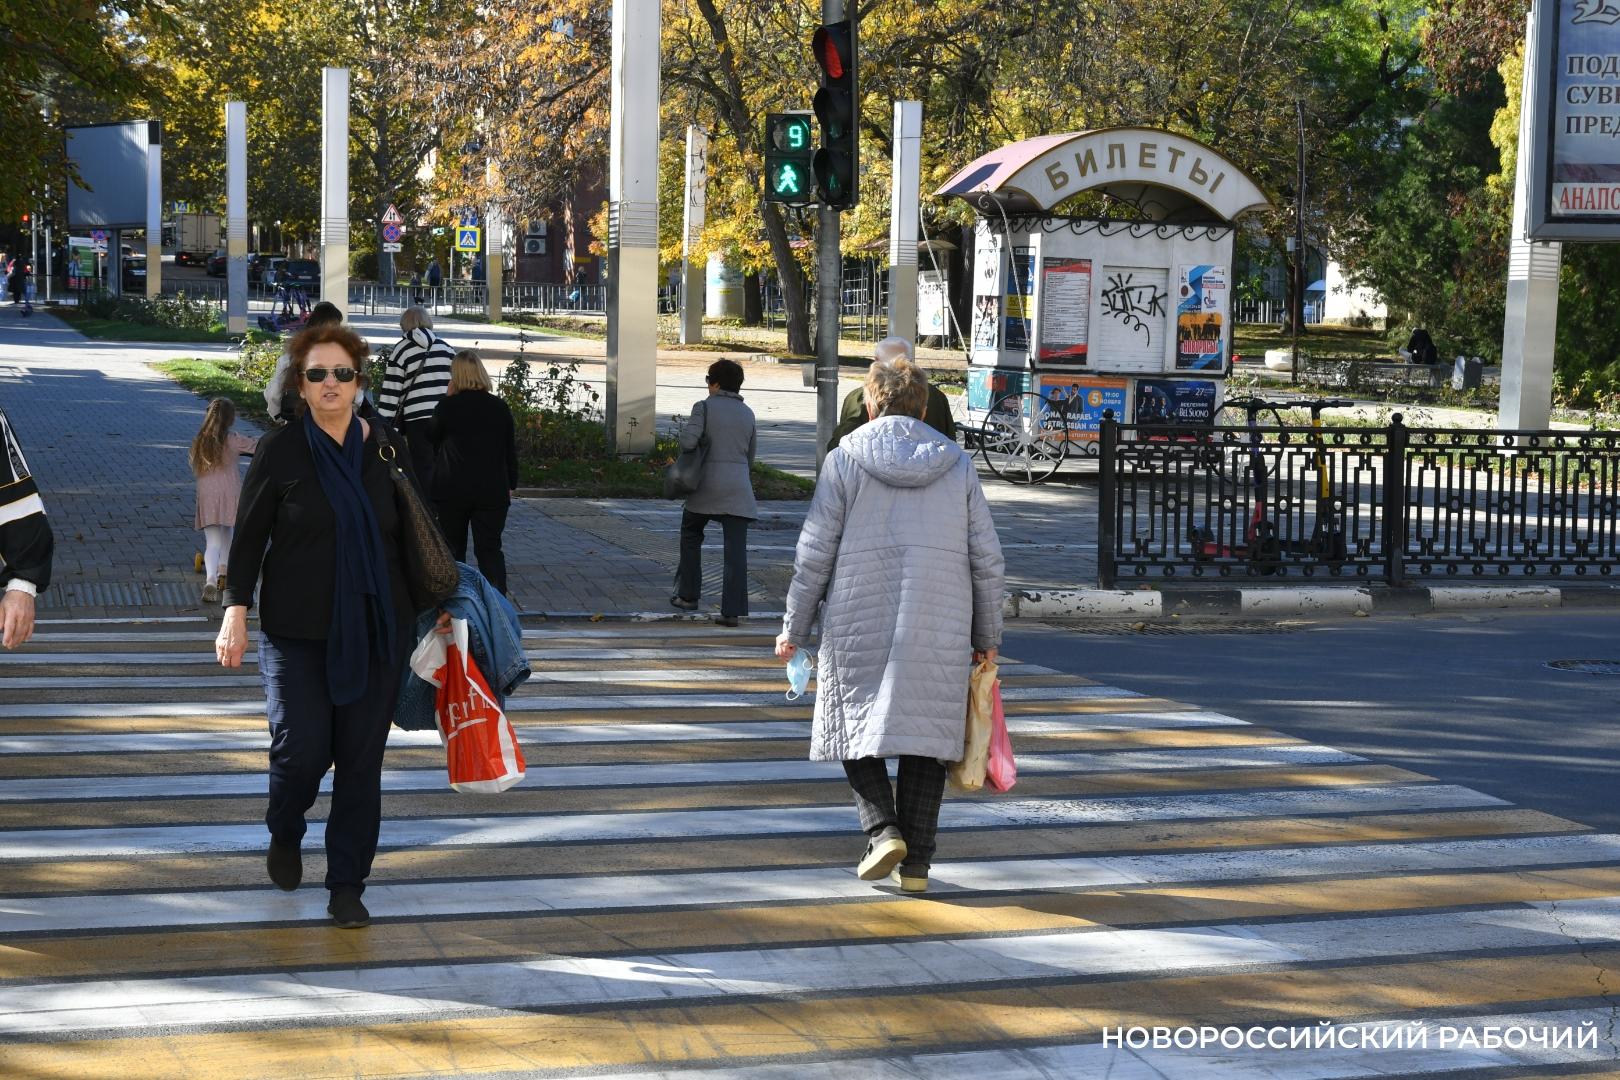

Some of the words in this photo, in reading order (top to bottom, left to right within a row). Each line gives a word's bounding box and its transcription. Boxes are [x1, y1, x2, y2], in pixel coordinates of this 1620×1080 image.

[1567, 56, 1620, 79] ПОД
[789, 125, 803, 148] 9
[1045, 143, 1225, 194] БИЛЕТЫ
[1091, 392, 1099, 404] 5
[1195, 387, 1205, 397] 27
[1066, 412, 1093, 421] RAFAEL
